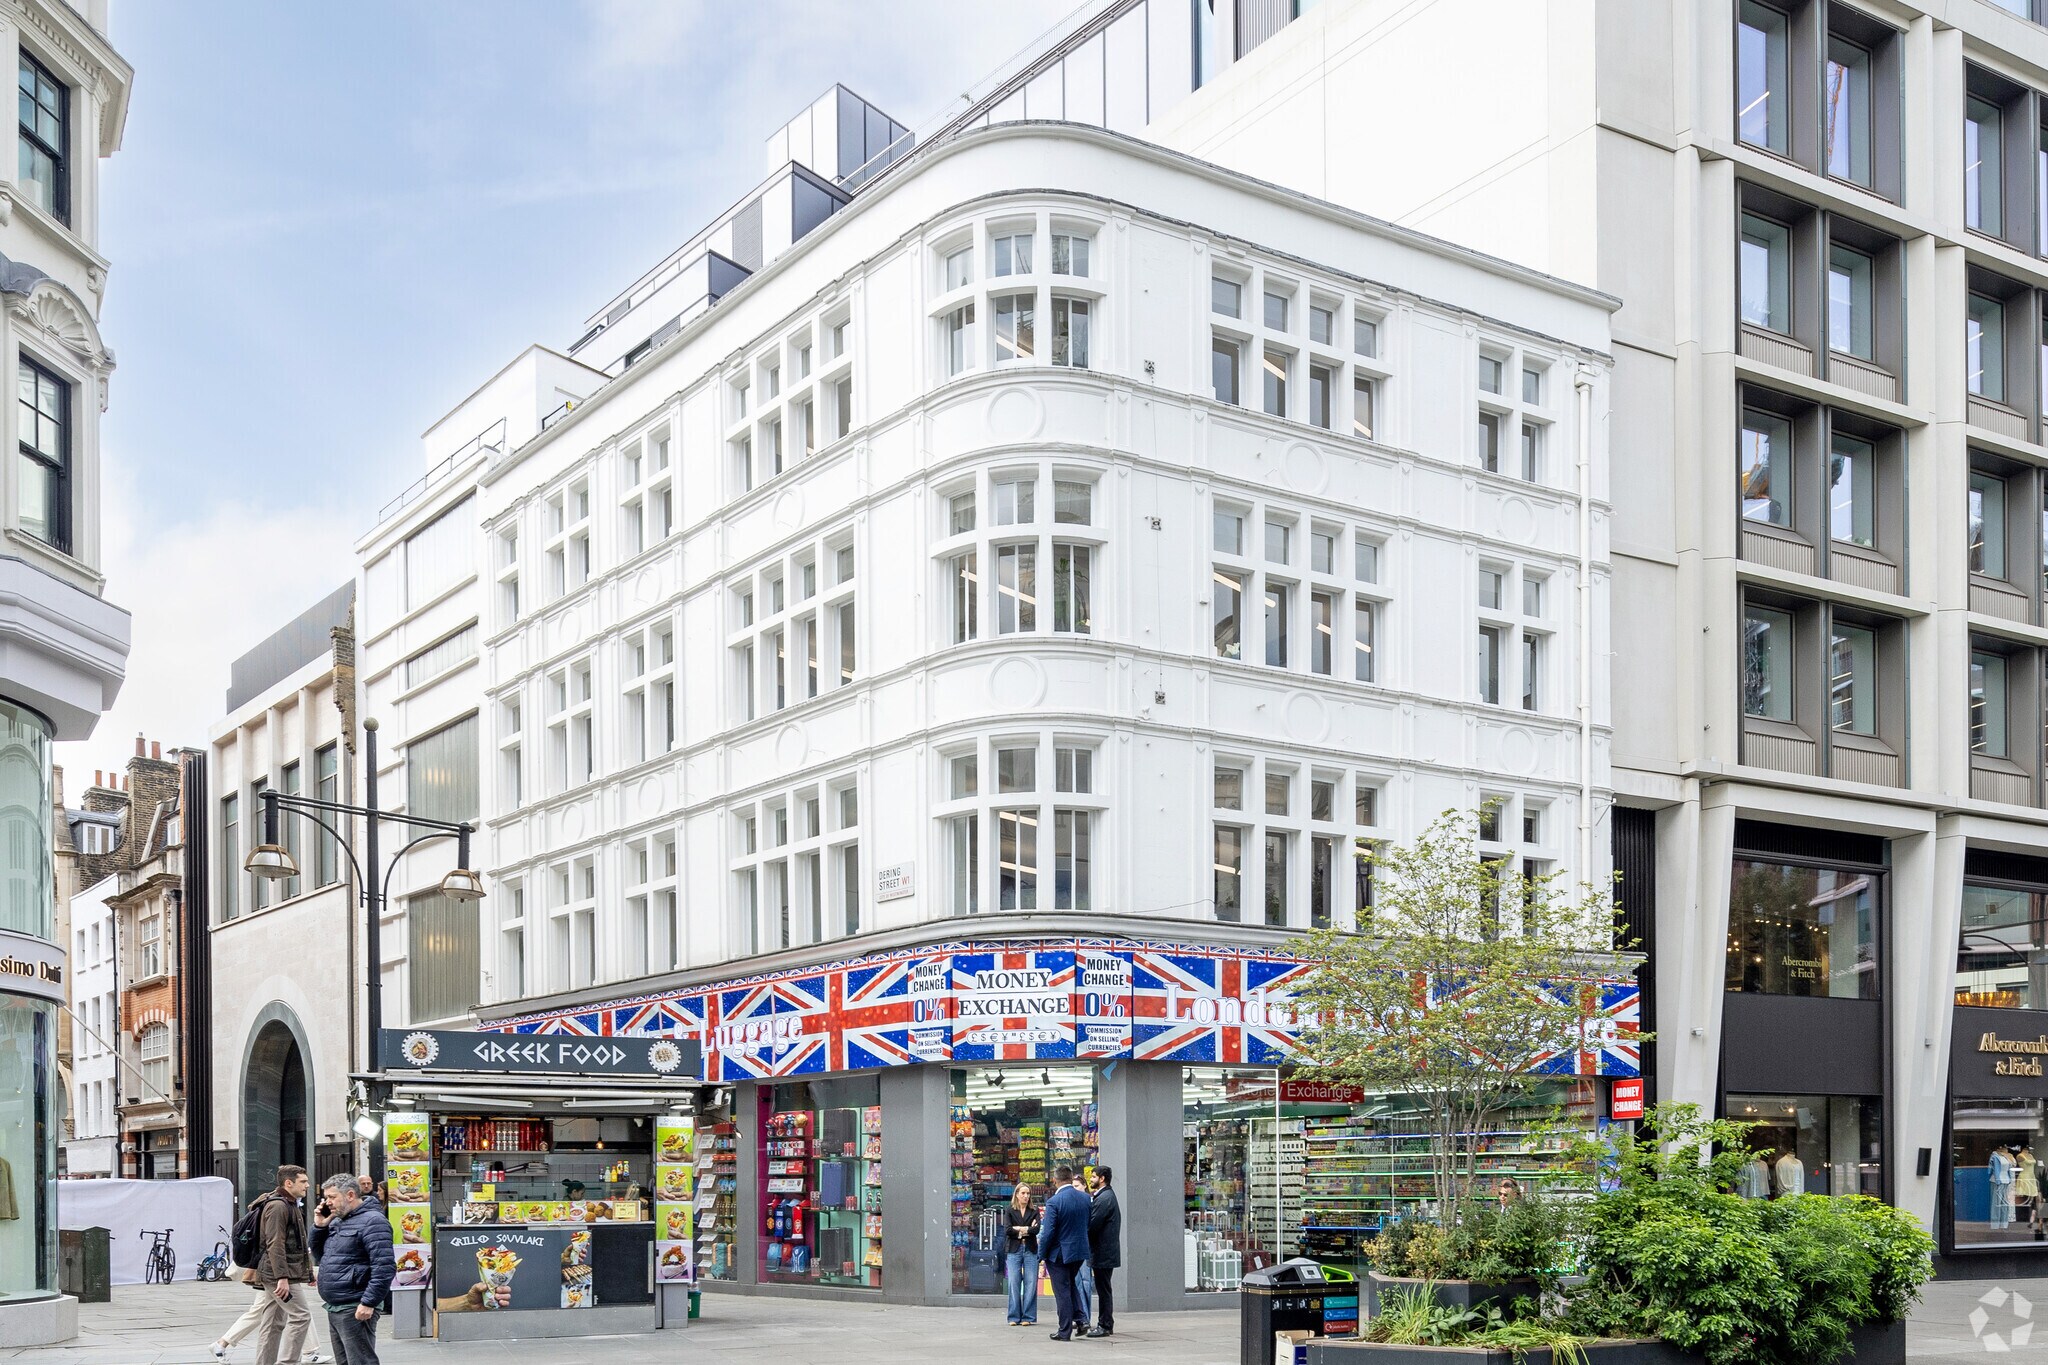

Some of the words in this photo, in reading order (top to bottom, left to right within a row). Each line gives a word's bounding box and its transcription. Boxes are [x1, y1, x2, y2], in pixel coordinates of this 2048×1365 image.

[878, 867, 901, 880] DERING
[878, 877, 900, 891] STREET
[1086, 958, 1122, 971] MONEY
[1781, 955, 1824, 968] Abercrombi
[915, 964, 943, 978] MONEY
[1790, 969, 1797, 978] &
[1797, 967, 1816, 979] Fitch
[913, 978, 945, 993] CHANGE
[976, 971, 1052, 990] MONEY
[1084, 973, 1124, 986] CHANGE
[914, 997, 945, 1023] 0%
[958, 996, 1069, 1016] EXCHANGE
[1085, 992, 1125, 1017] 0%
[698, 1014, 803, 1058] Luggage
[915, 1030, 943, 1039] COMMISSION
[473, 1041, 551, 1065] GREEK
[559, 1043, 627, 1066] FOOD
[916, 1047, 942, 1055] CURRENCIES
[1995, 1060, 2009, 1076] &
[2008, 1056, 2044, 1077] Fitch
[1286, 1083, 1352, 1101] Exchange
[1615, 1086, 1640, 1099] MONEY
[1614, 1100, 1642, 1112] CHANGE
